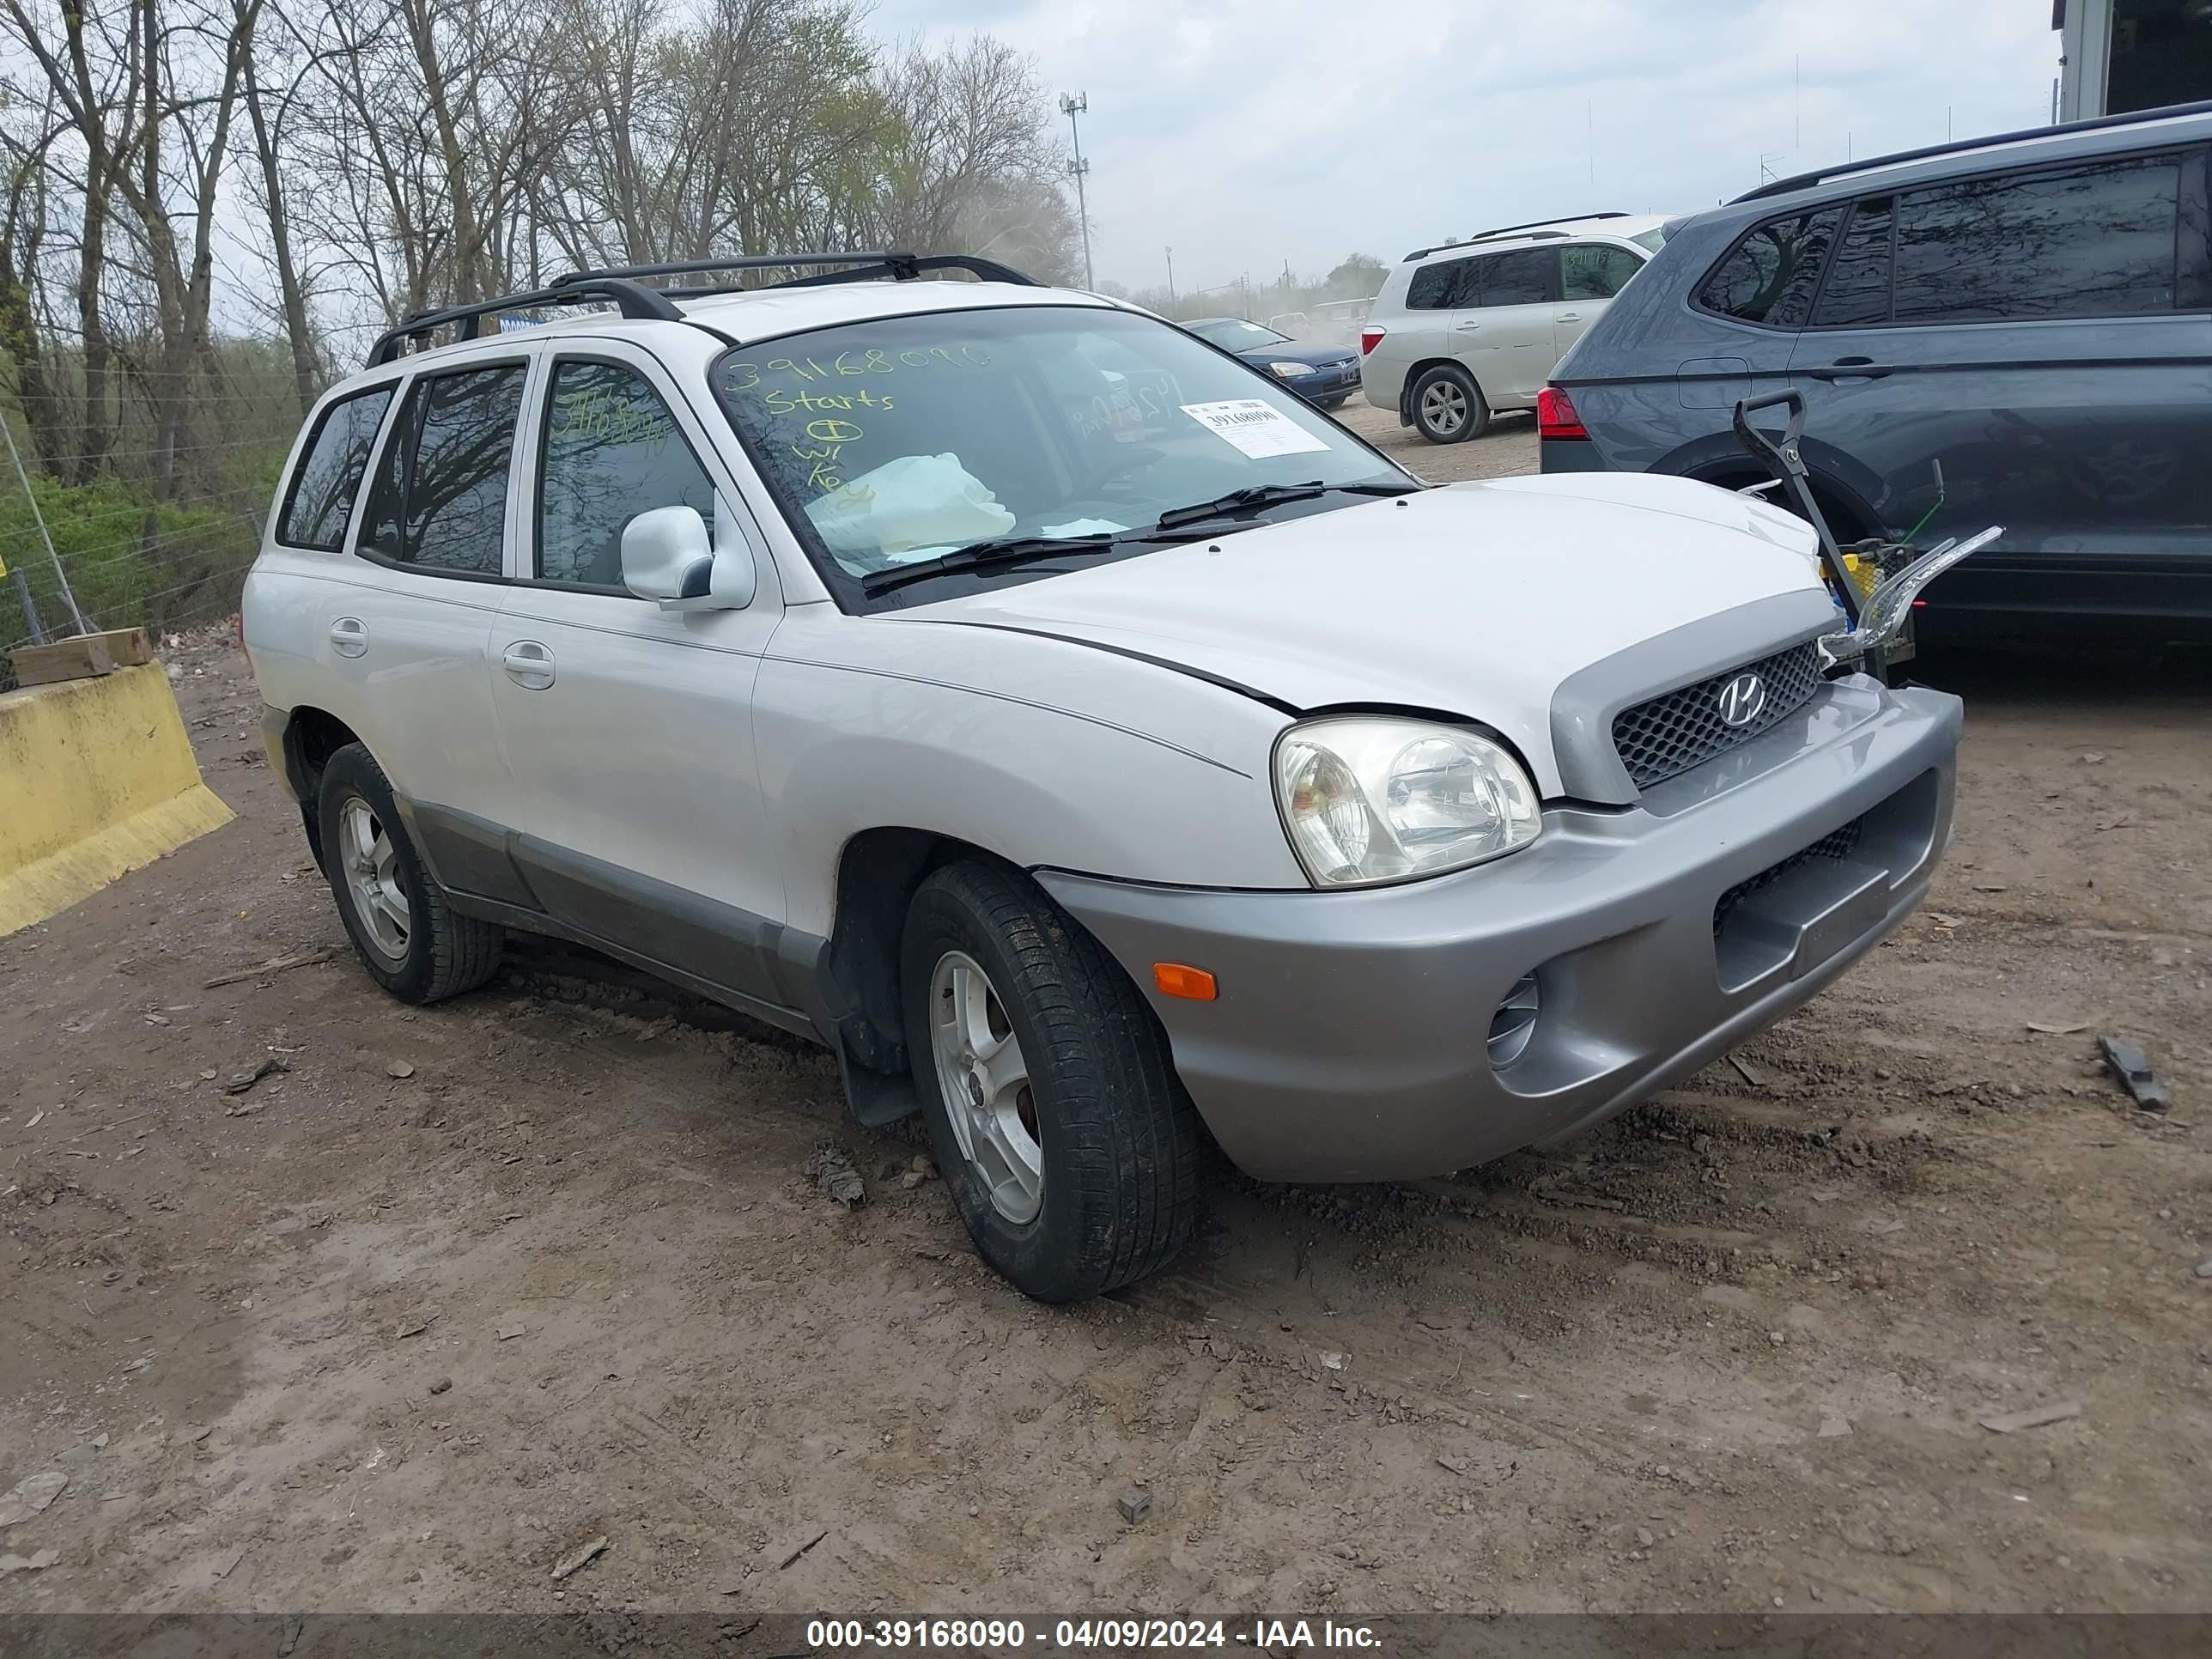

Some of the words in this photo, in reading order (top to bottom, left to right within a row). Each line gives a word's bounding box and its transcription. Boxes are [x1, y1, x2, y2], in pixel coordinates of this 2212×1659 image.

[725, 345, 991, 392] 39168090
[764, 390, 895, 416] Starts
[1206, 410, 1279, 427] 39168090
